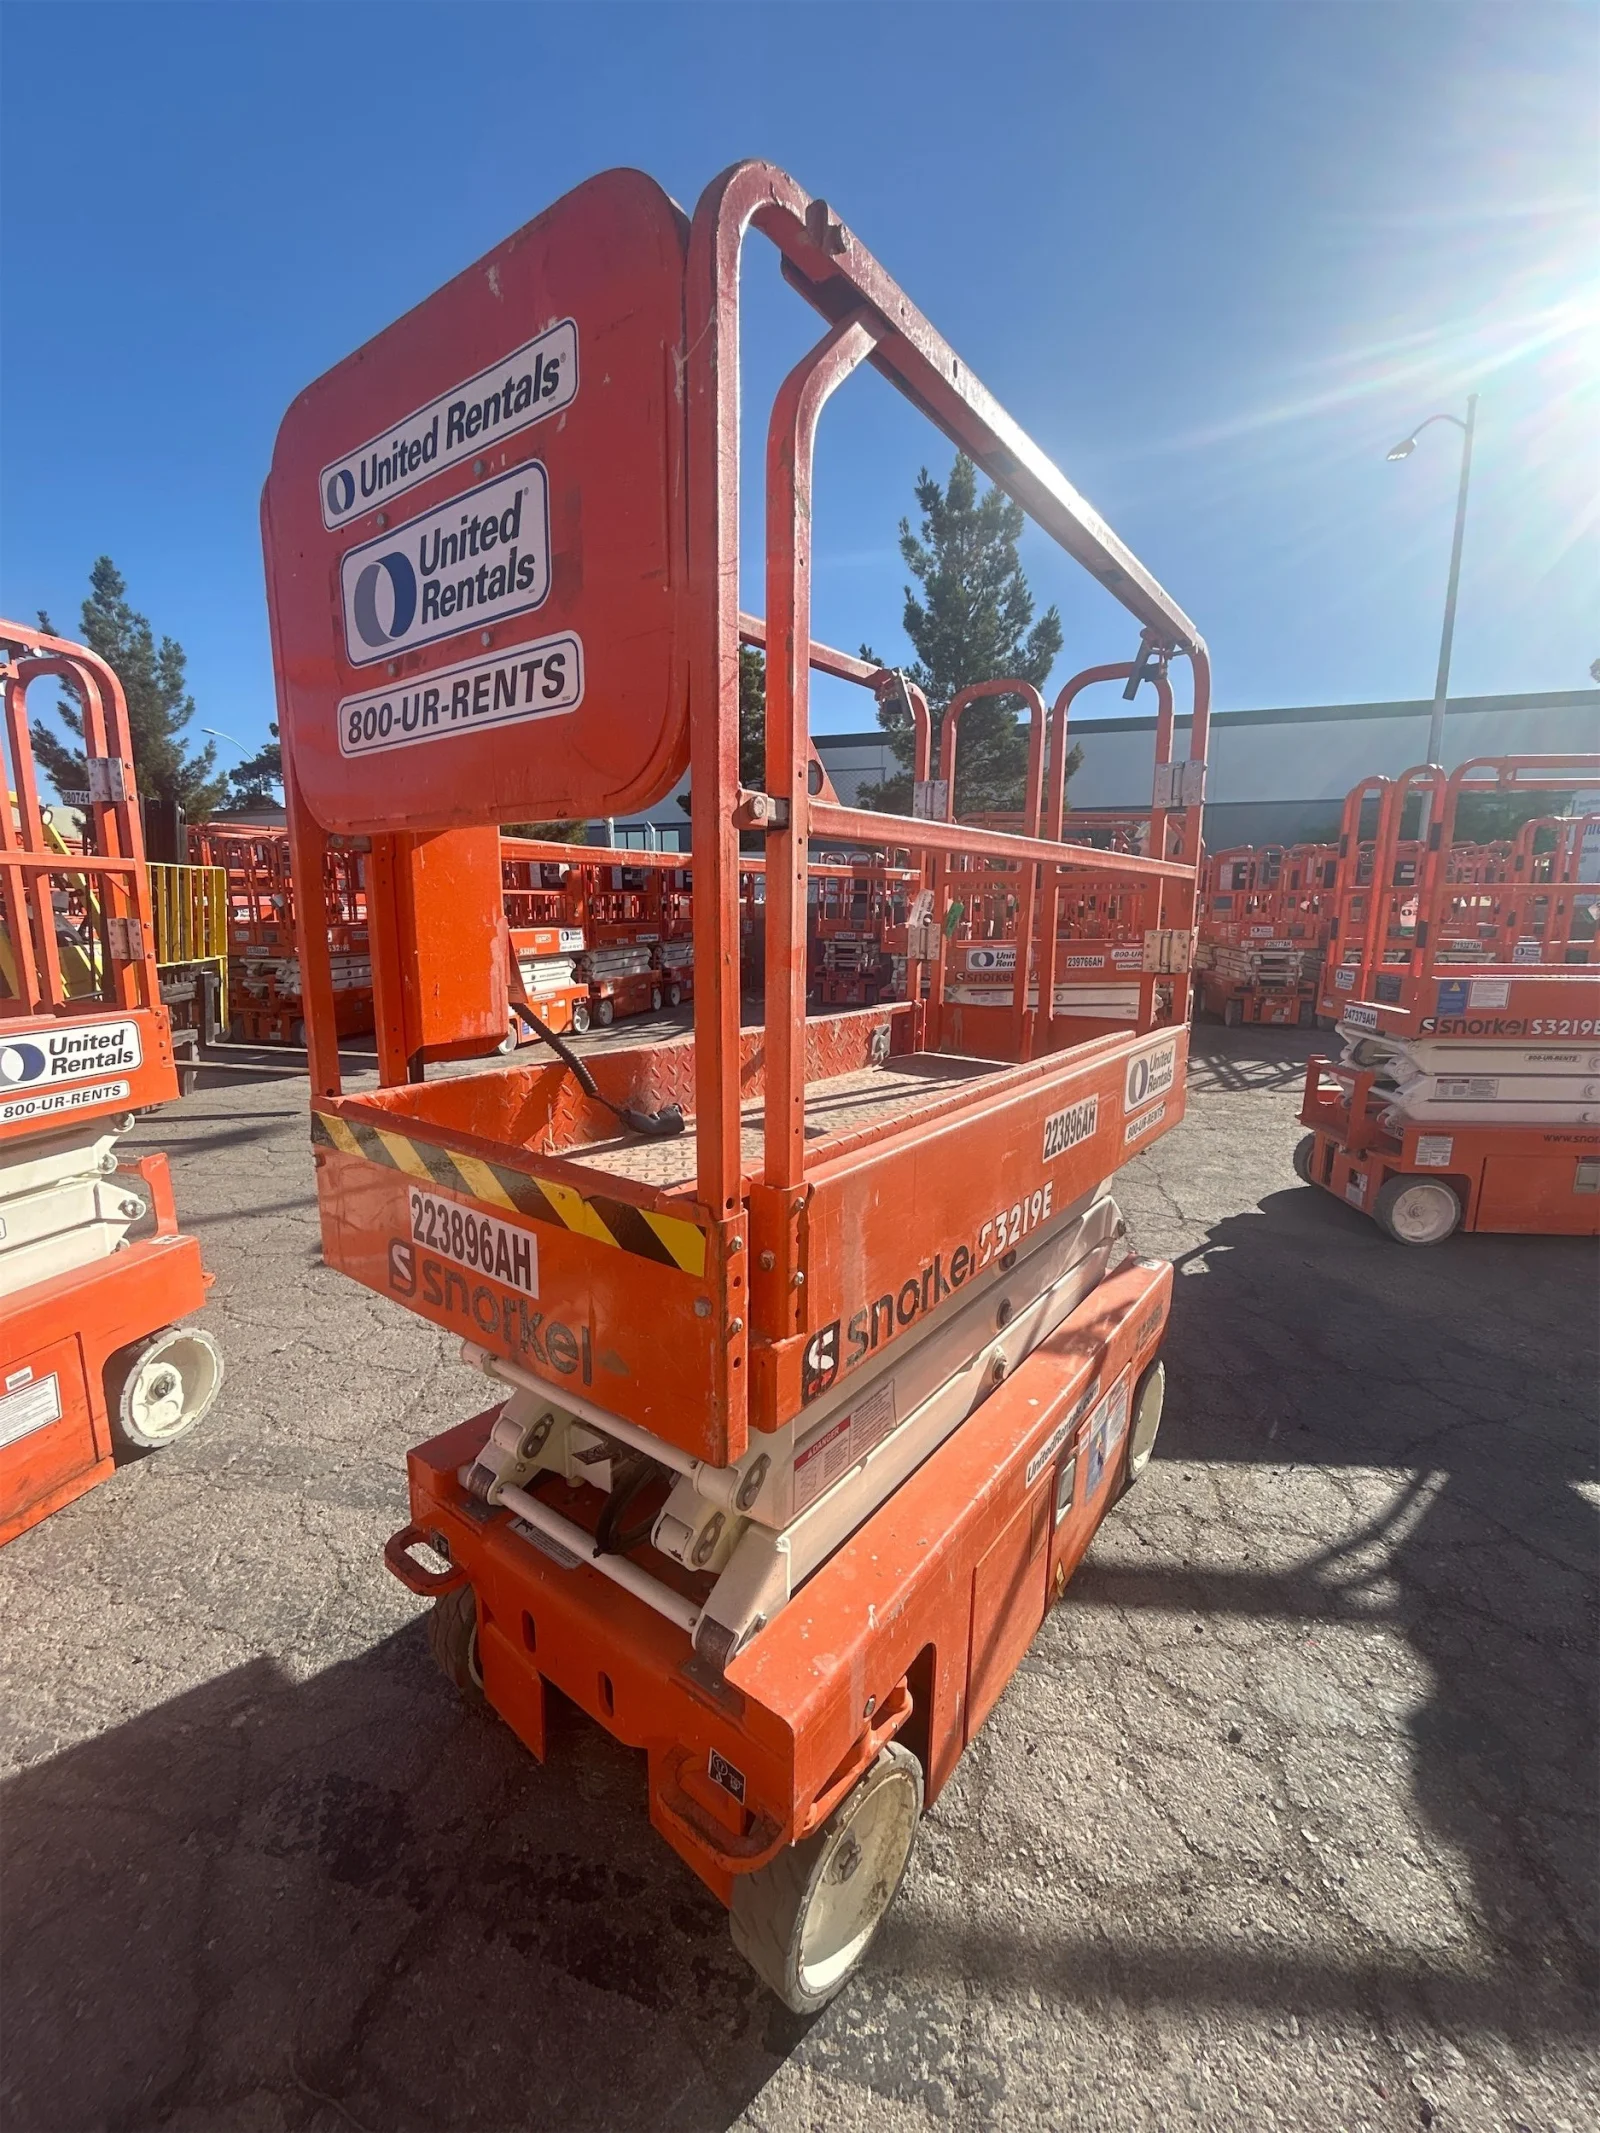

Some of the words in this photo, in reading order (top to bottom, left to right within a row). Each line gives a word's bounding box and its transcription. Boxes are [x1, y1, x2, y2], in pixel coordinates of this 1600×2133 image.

[361, 415, 438, 497] United
[446, 352, 560, 450] Rentals
[420, 490, 523, 576] United
[421, 546, 535, 624] Rentals
[348, 653, 566, 744] 800-UR-RENTS
[996, 951, 1016, 960] Unit
[1067, 957, 1103, 967] 239766AH
[1344, 1008, 1376, 1026] 247379AH
[1440, 1018, 1529, 1035] snorkel
[49, 1029, 125, 1056] United
[51, 1048, 134, 1075] Rentals
[1149, 1046, 1173, 1073] United
[1147, 1067, 1173, 1093] Rentals
[3, 1085, 121, 1118] 800-UR-RENTS
[1044, 1104, 1096, 1160] 223896AH
[1127, 1107, 1164, 1139] 800-UR-RENTS
[979, 1180, 1053, 1268] S3219E
[412, 1194, 532, 1291] 223896AH
[422, 1259, 593, 1387] snorkel
[812, 1427, 840, 1453] DANGER
